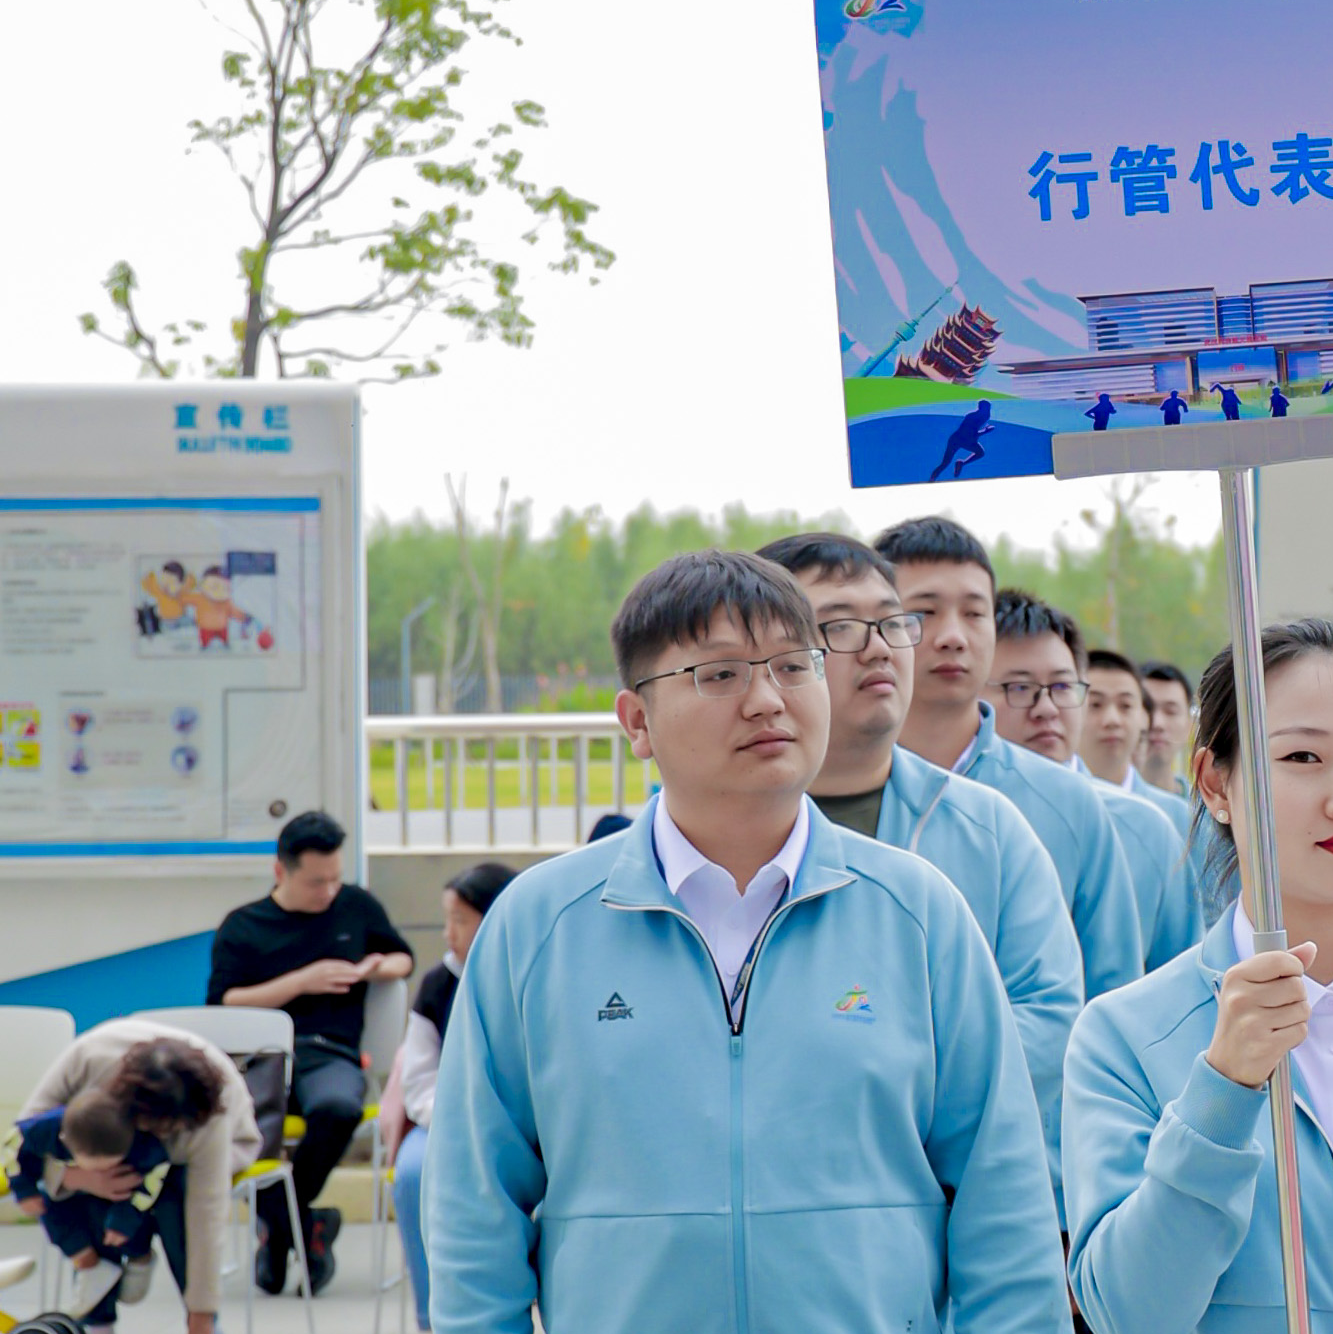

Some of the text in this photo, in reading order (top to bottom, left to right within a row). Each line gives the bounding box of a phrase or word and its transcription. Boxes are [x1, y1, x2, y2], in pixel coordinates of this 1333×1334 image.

[174, 402, 290, 430] 宣传栏
[597, 1007, 635, 1022] PEAK
